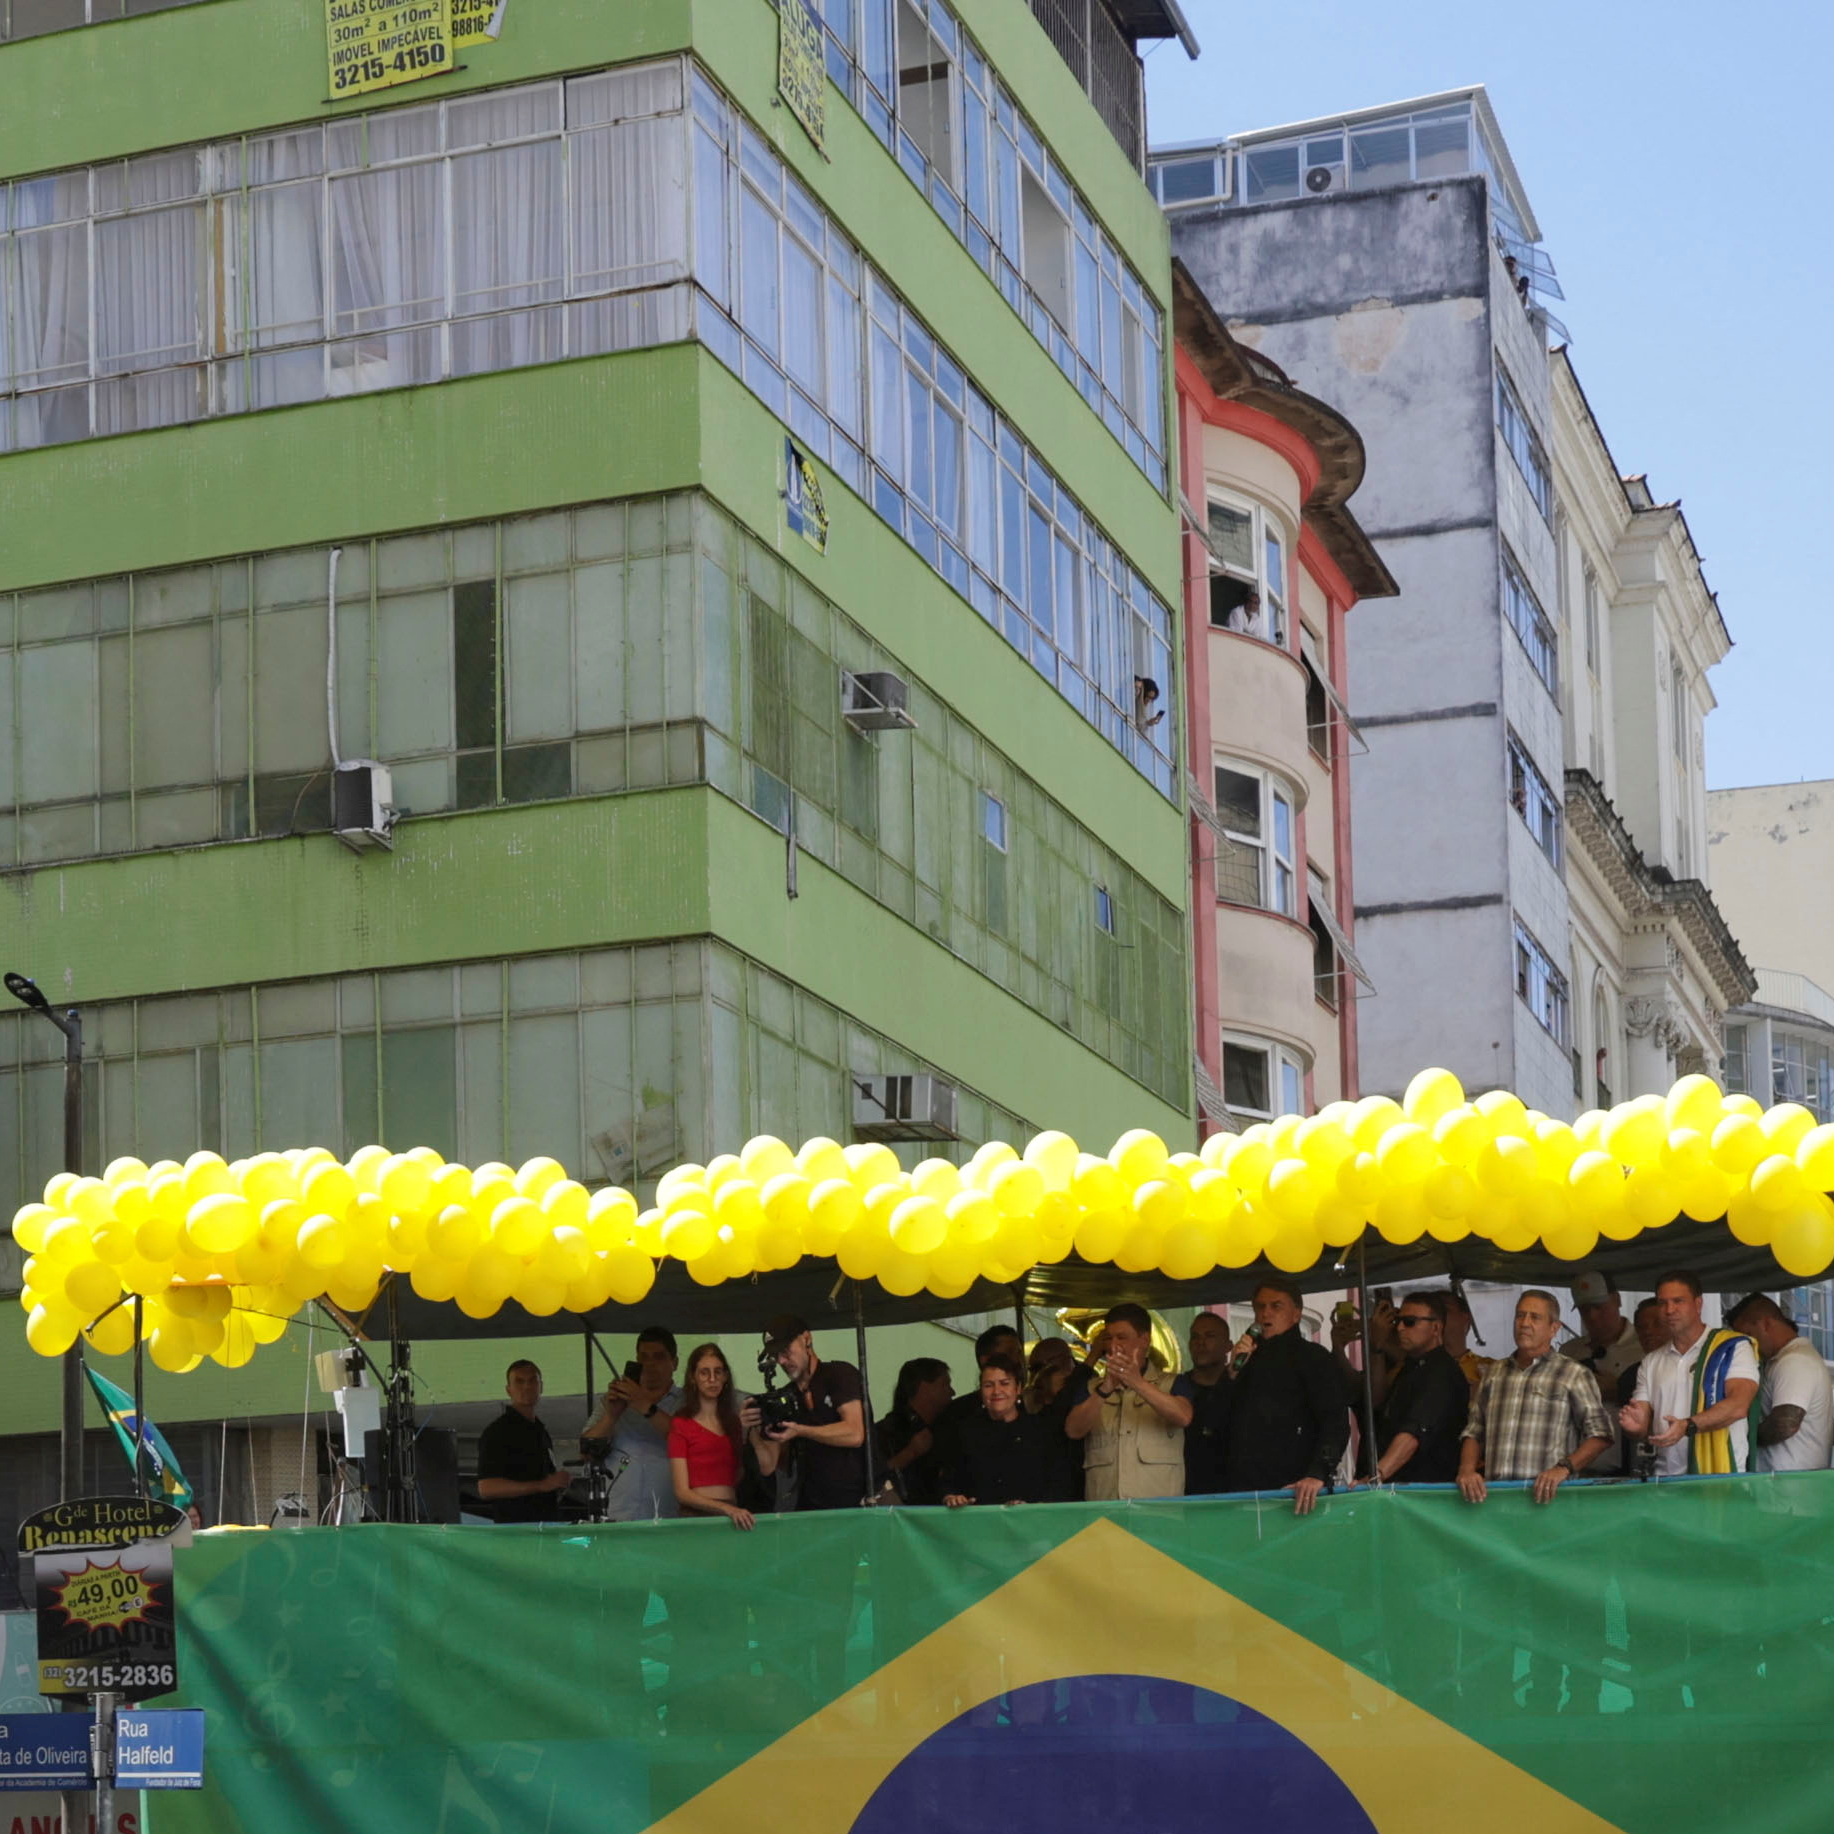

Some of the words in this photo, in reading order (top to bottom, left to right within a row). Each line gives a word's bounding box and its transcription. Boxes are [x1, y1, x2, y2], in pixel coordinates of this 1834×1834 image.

[330, 1, 365, 22] SALAS
[378, 20, 387, 32] a
[335, 43, 446, 90] 3215-4150
[94, 1501, 150, 1525] Hotel
[77, 1575, 138, 1606] 49,00
[64, 1665, 173, 1687] 3215-2836
[119, 1719, 148, 1737] Rua
[16, 1746, 32, 1765] de
[36, 1745, 88, 1765] Oliveira
[119, 1746, 174, 1764] Halfeld
